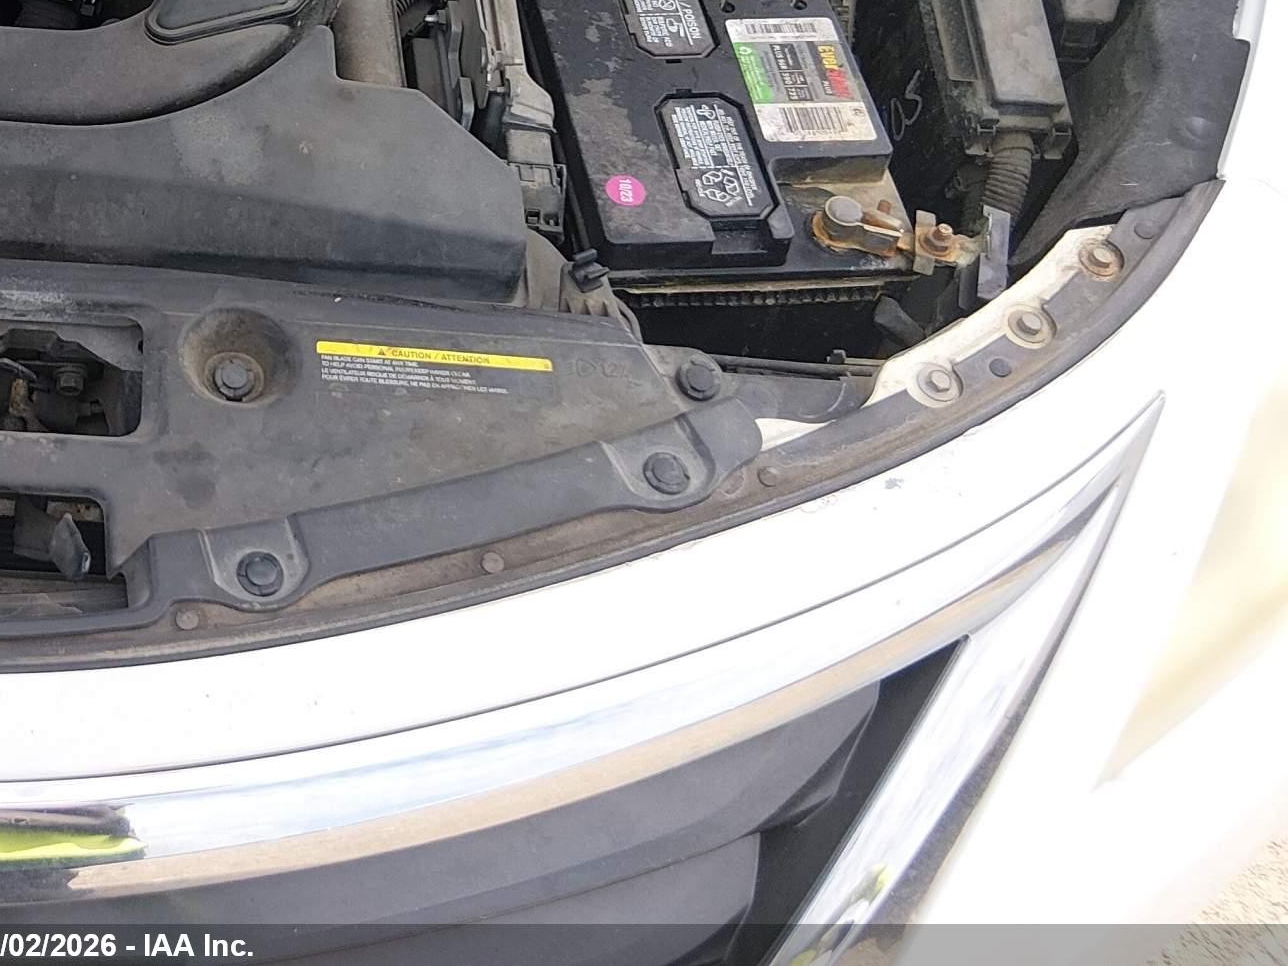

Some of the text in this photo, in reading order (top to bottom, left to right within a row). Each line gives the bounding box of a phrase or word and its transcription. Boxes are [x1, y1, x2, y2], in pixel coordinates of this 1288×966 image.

[683, 9, 701, 39] POISON
[619, 179, 633, 202] 10/23
[392, 350, 431, 359] CAUTION
[441, 354, 490, 364] ATTENTION
